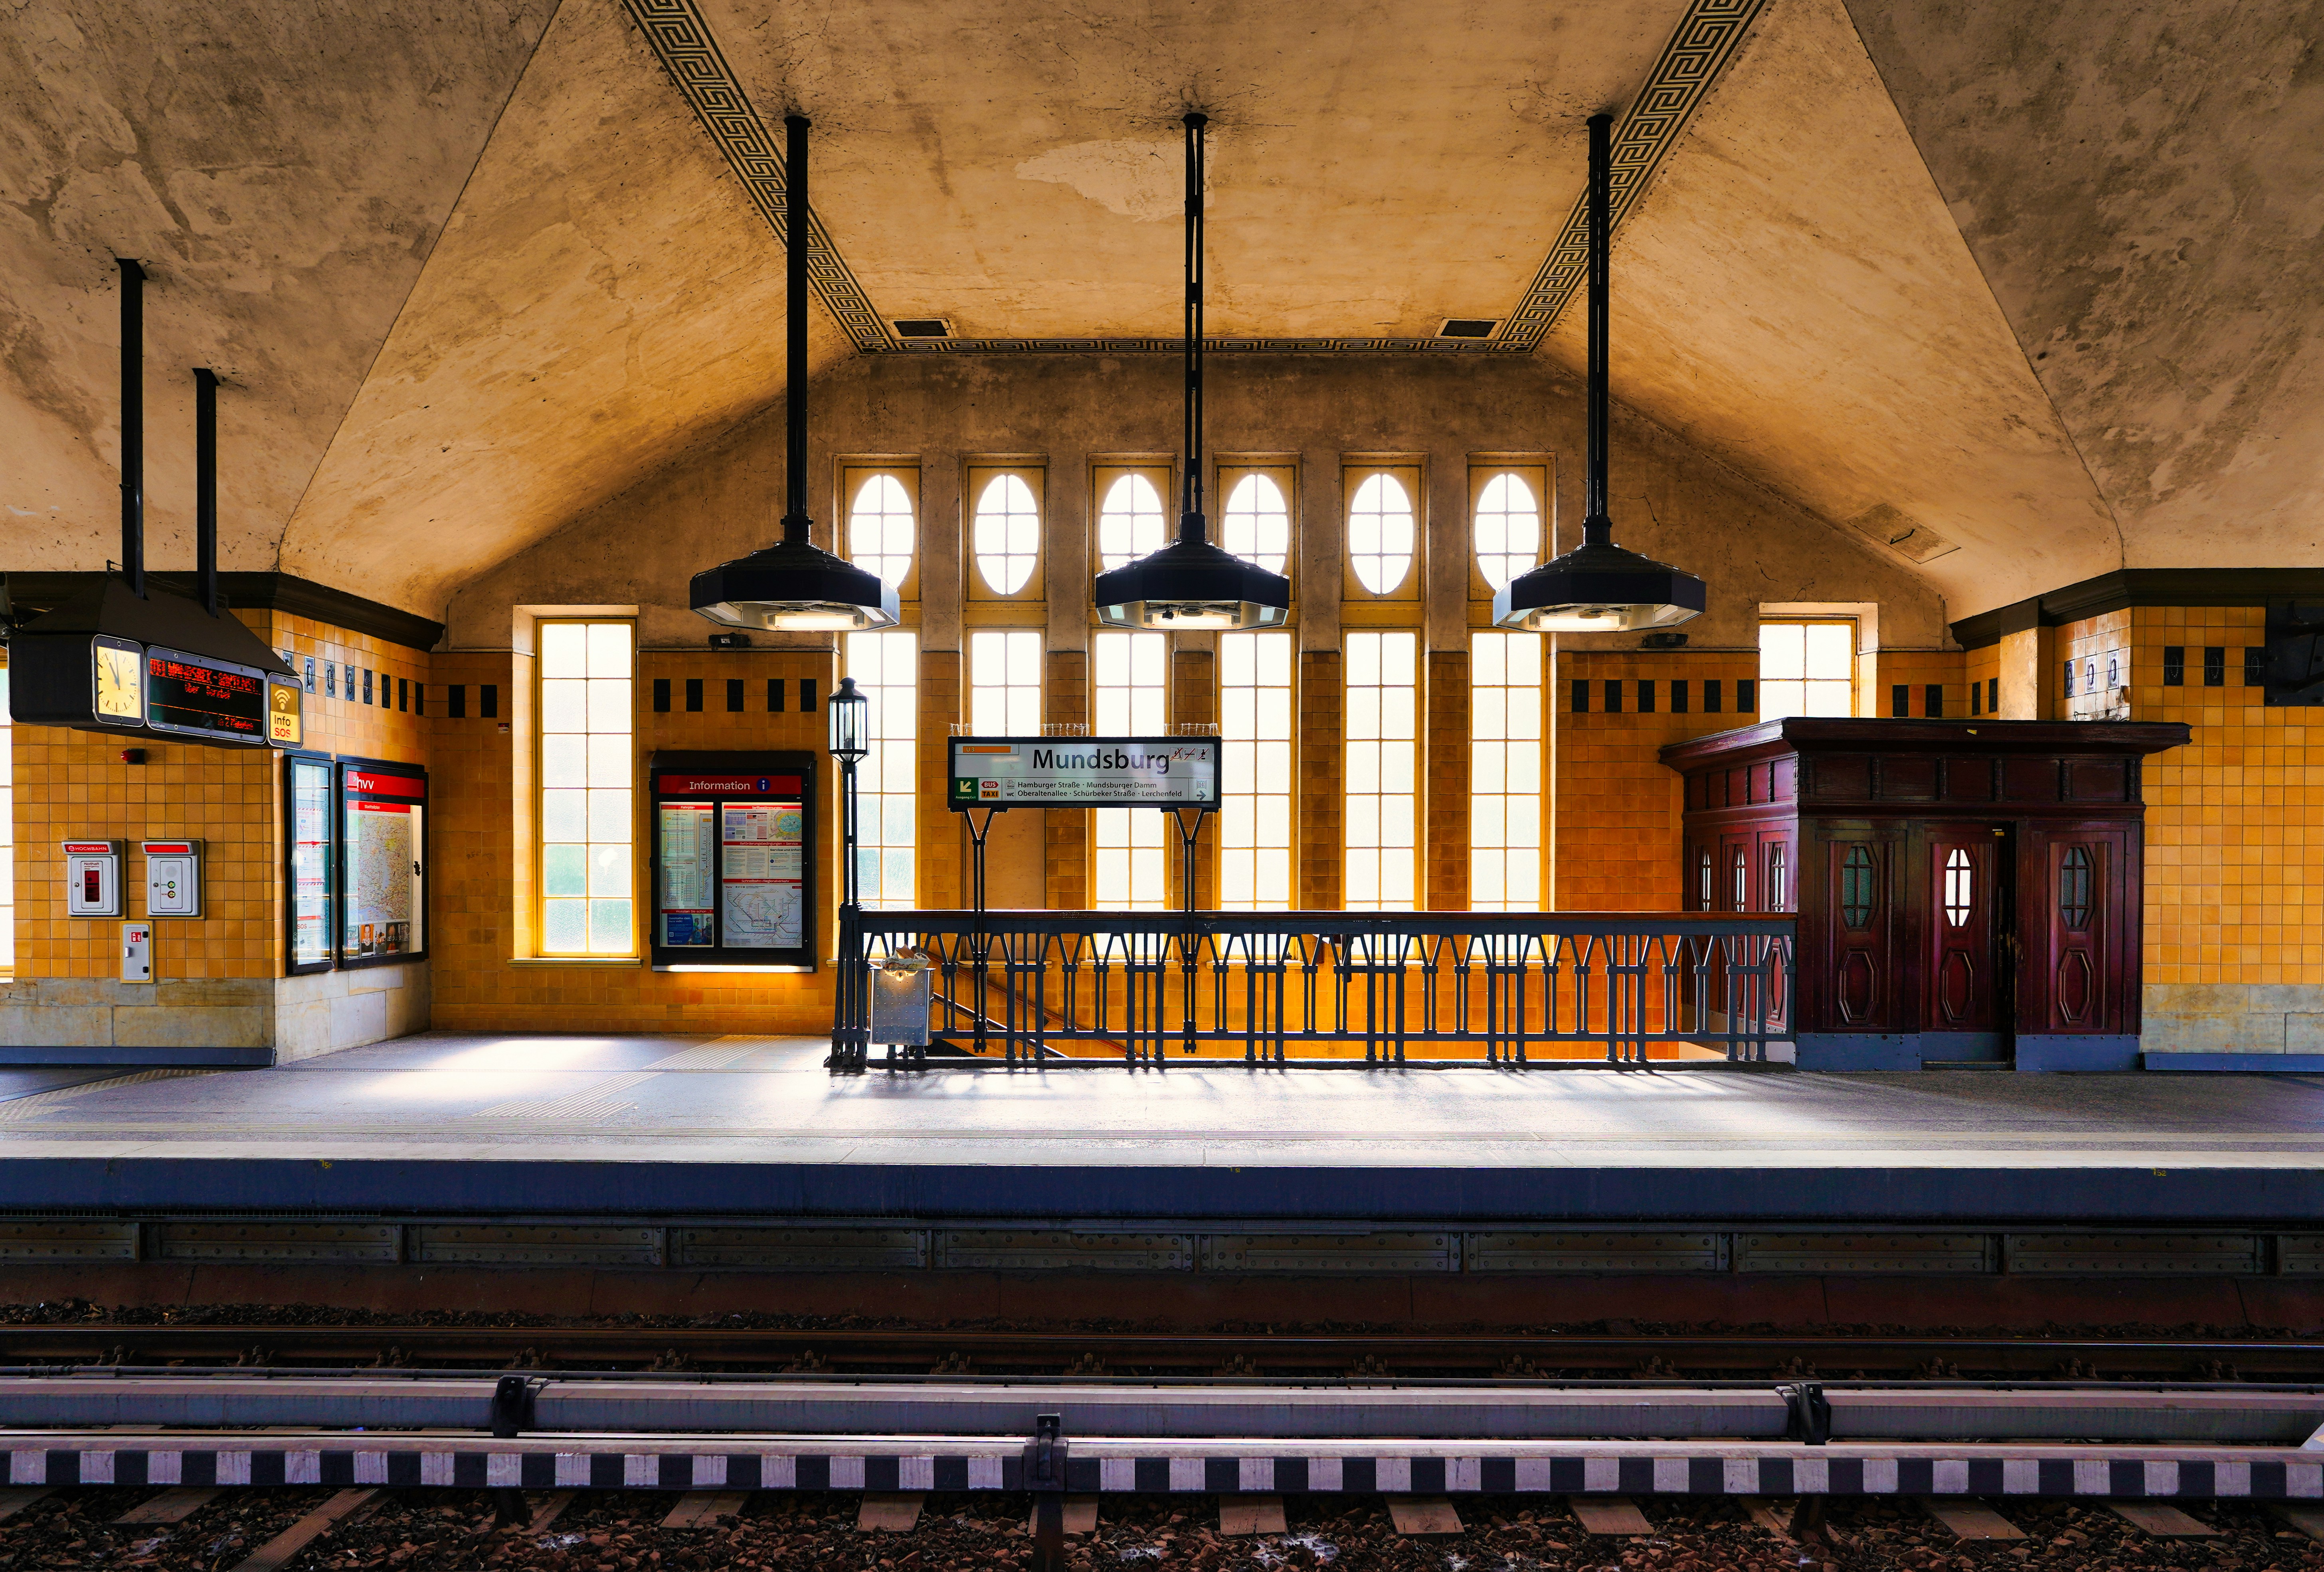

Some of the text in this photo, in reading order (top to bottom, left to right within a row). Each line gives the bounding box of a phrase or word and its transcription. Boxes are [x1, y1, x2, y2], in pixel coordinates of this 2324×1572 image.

[275, 715, 291, 726] Info
[275, 727, 291, 738] SOS
[1033, 748, 1170, 775] Mundsburg
[356, 776, 374, 790] hvv
[689, 781, 750, 790] Information
